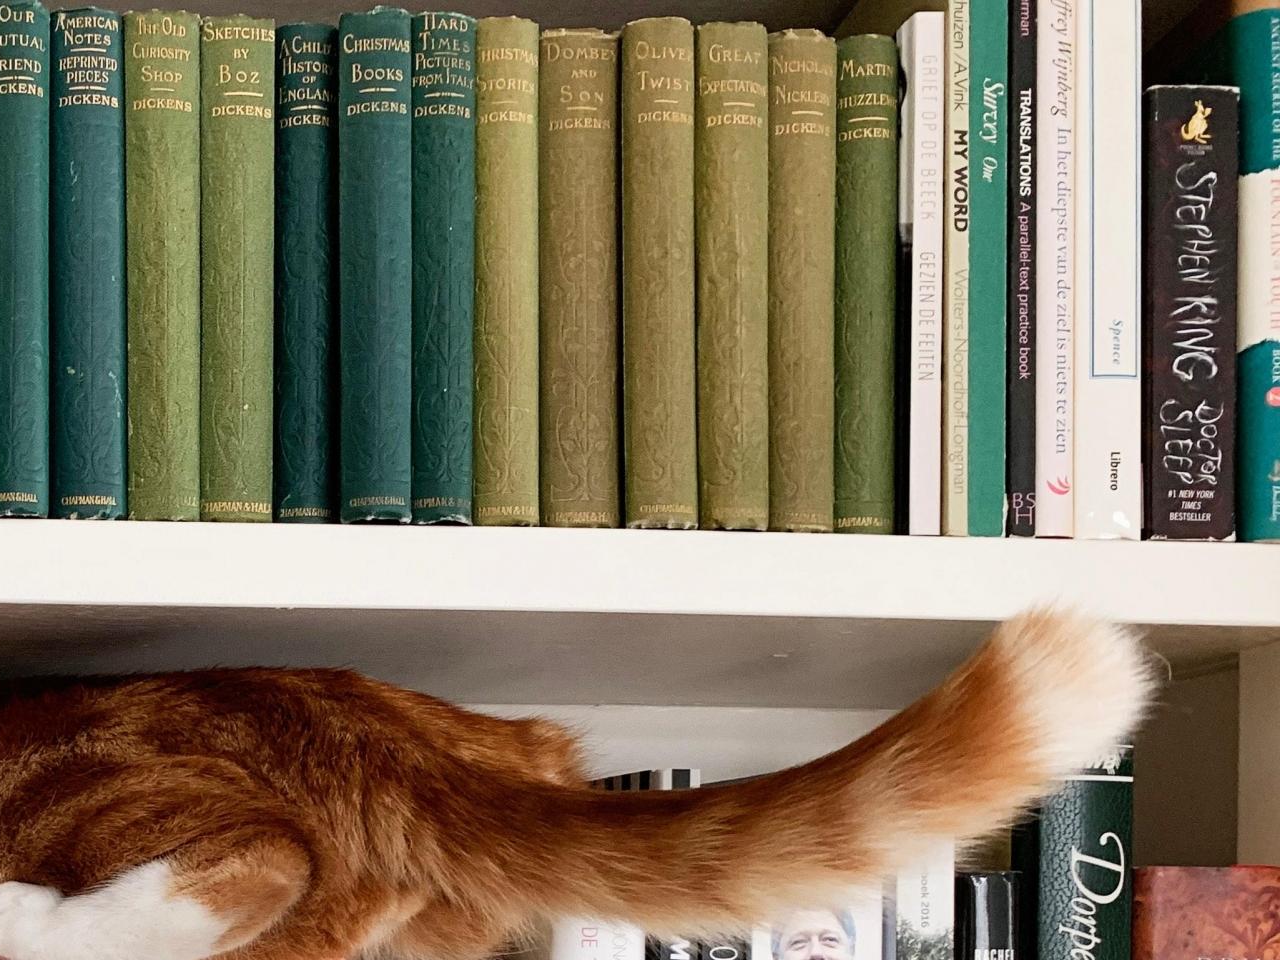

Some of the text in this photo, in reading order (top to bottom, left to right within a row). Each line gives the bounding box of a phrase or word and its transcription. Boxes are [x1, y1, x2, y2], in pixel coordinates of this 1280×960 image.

[54, 14, 119, 33] AMERICAN
[64, 31, 112, 46] NOTES
[343, 34, 410, 55] CHRISTMAS
[59, 57, 117, 72] REPRINTED
[352, 64, 404, 83] BOOKS
[66, 70, 109, 84] PIECES
[59, 94, 119, 109] DICKENS
[346, 101, 408, 117] DICKENS
[953, 129, 969, 232] MY WORD
[1175, 162, 1218, 283] STEPHEN
[1017, 88, 1033, 380] TRANSLATIONS practice book
[1172, 296, 1221, 382] KING
[1159, 398, 1194, 485] SLEEP
[1195, 400, 1225, 485] DOCTOR
[1110, 451, 1121, 491] Librero
[1178, 490, 1215, 499] NEW YORK
[1181, 502, 1202, 510] TIMES
[1169, 511, 1212, 521] BESTSELLER
